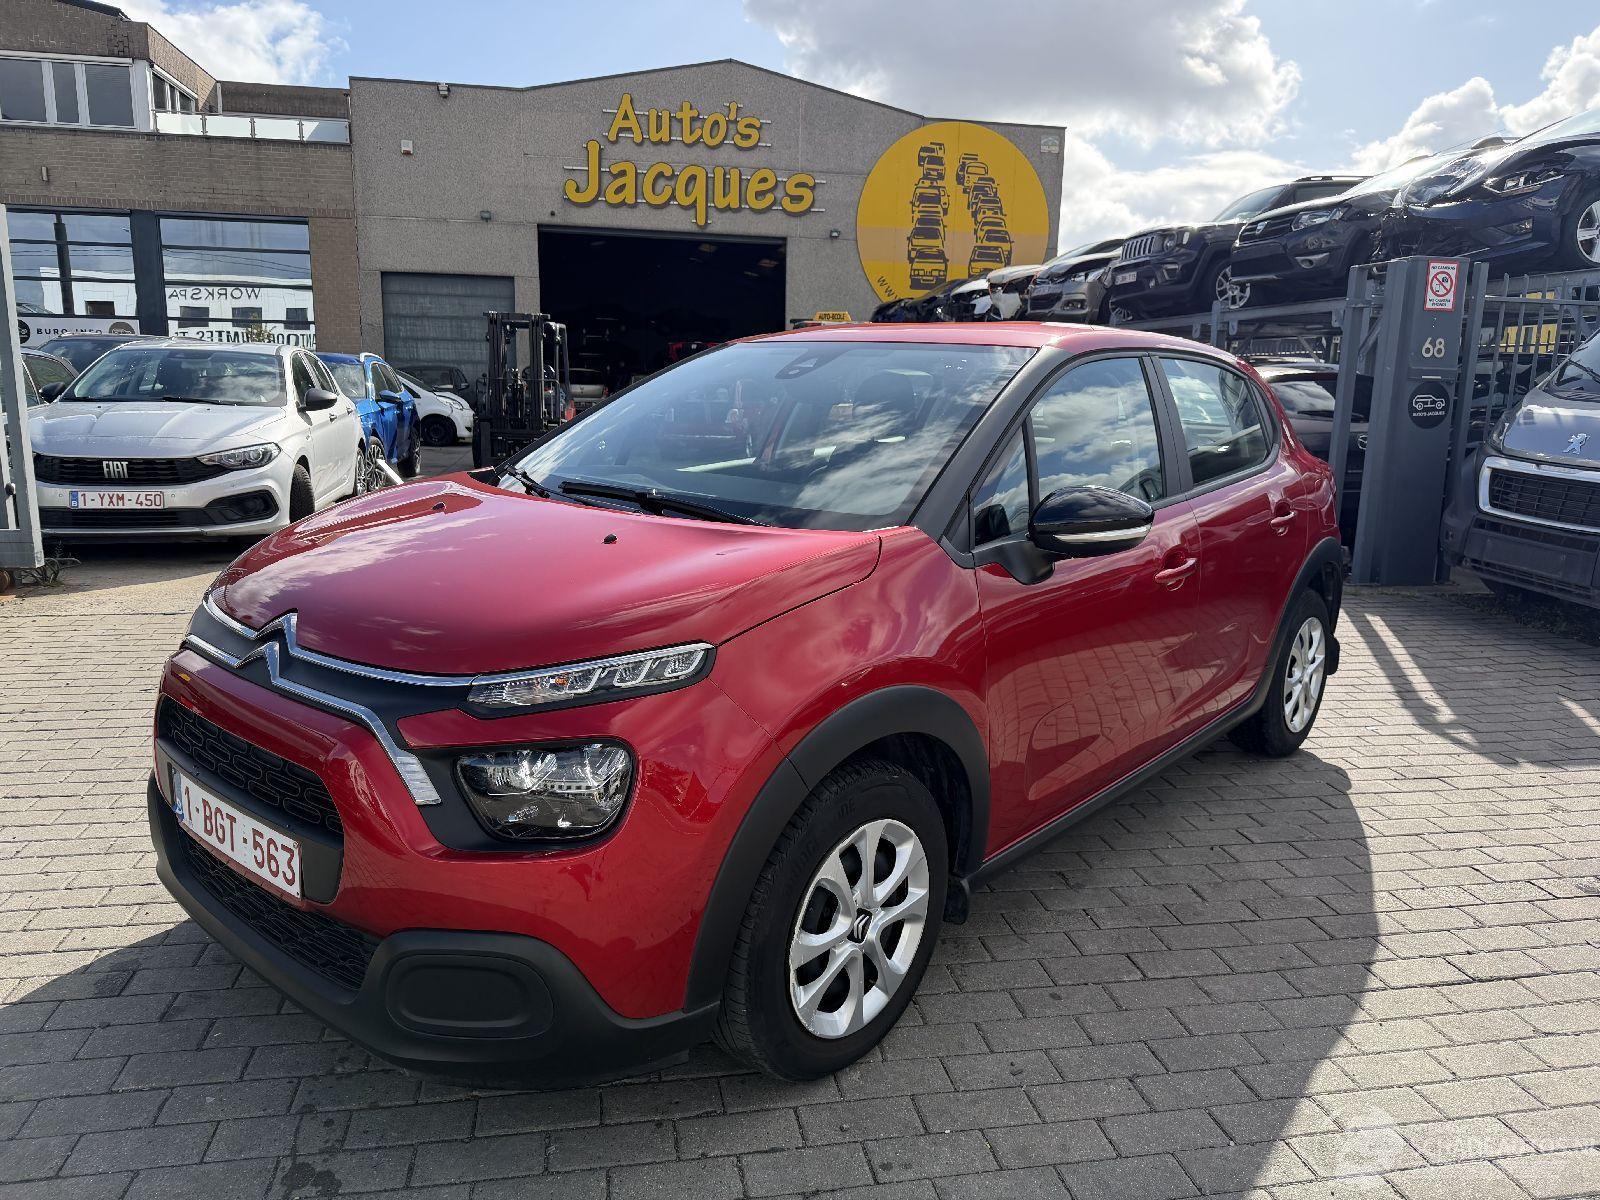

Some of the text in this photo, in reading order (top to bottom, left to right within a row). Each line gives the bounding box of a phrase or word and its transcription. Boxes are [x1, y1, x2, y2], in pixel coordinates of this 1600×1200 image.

[607, 92, 762, 148] Auto's
[564, 139, 815, 227] Jacques
[1422, 337, 1445, 358] 68
[102, 460, 129, 479] FIAT
[81, 492, 162, 508] 1-YXM-450
[184, 785, 296, 887] 1-BGT-563
